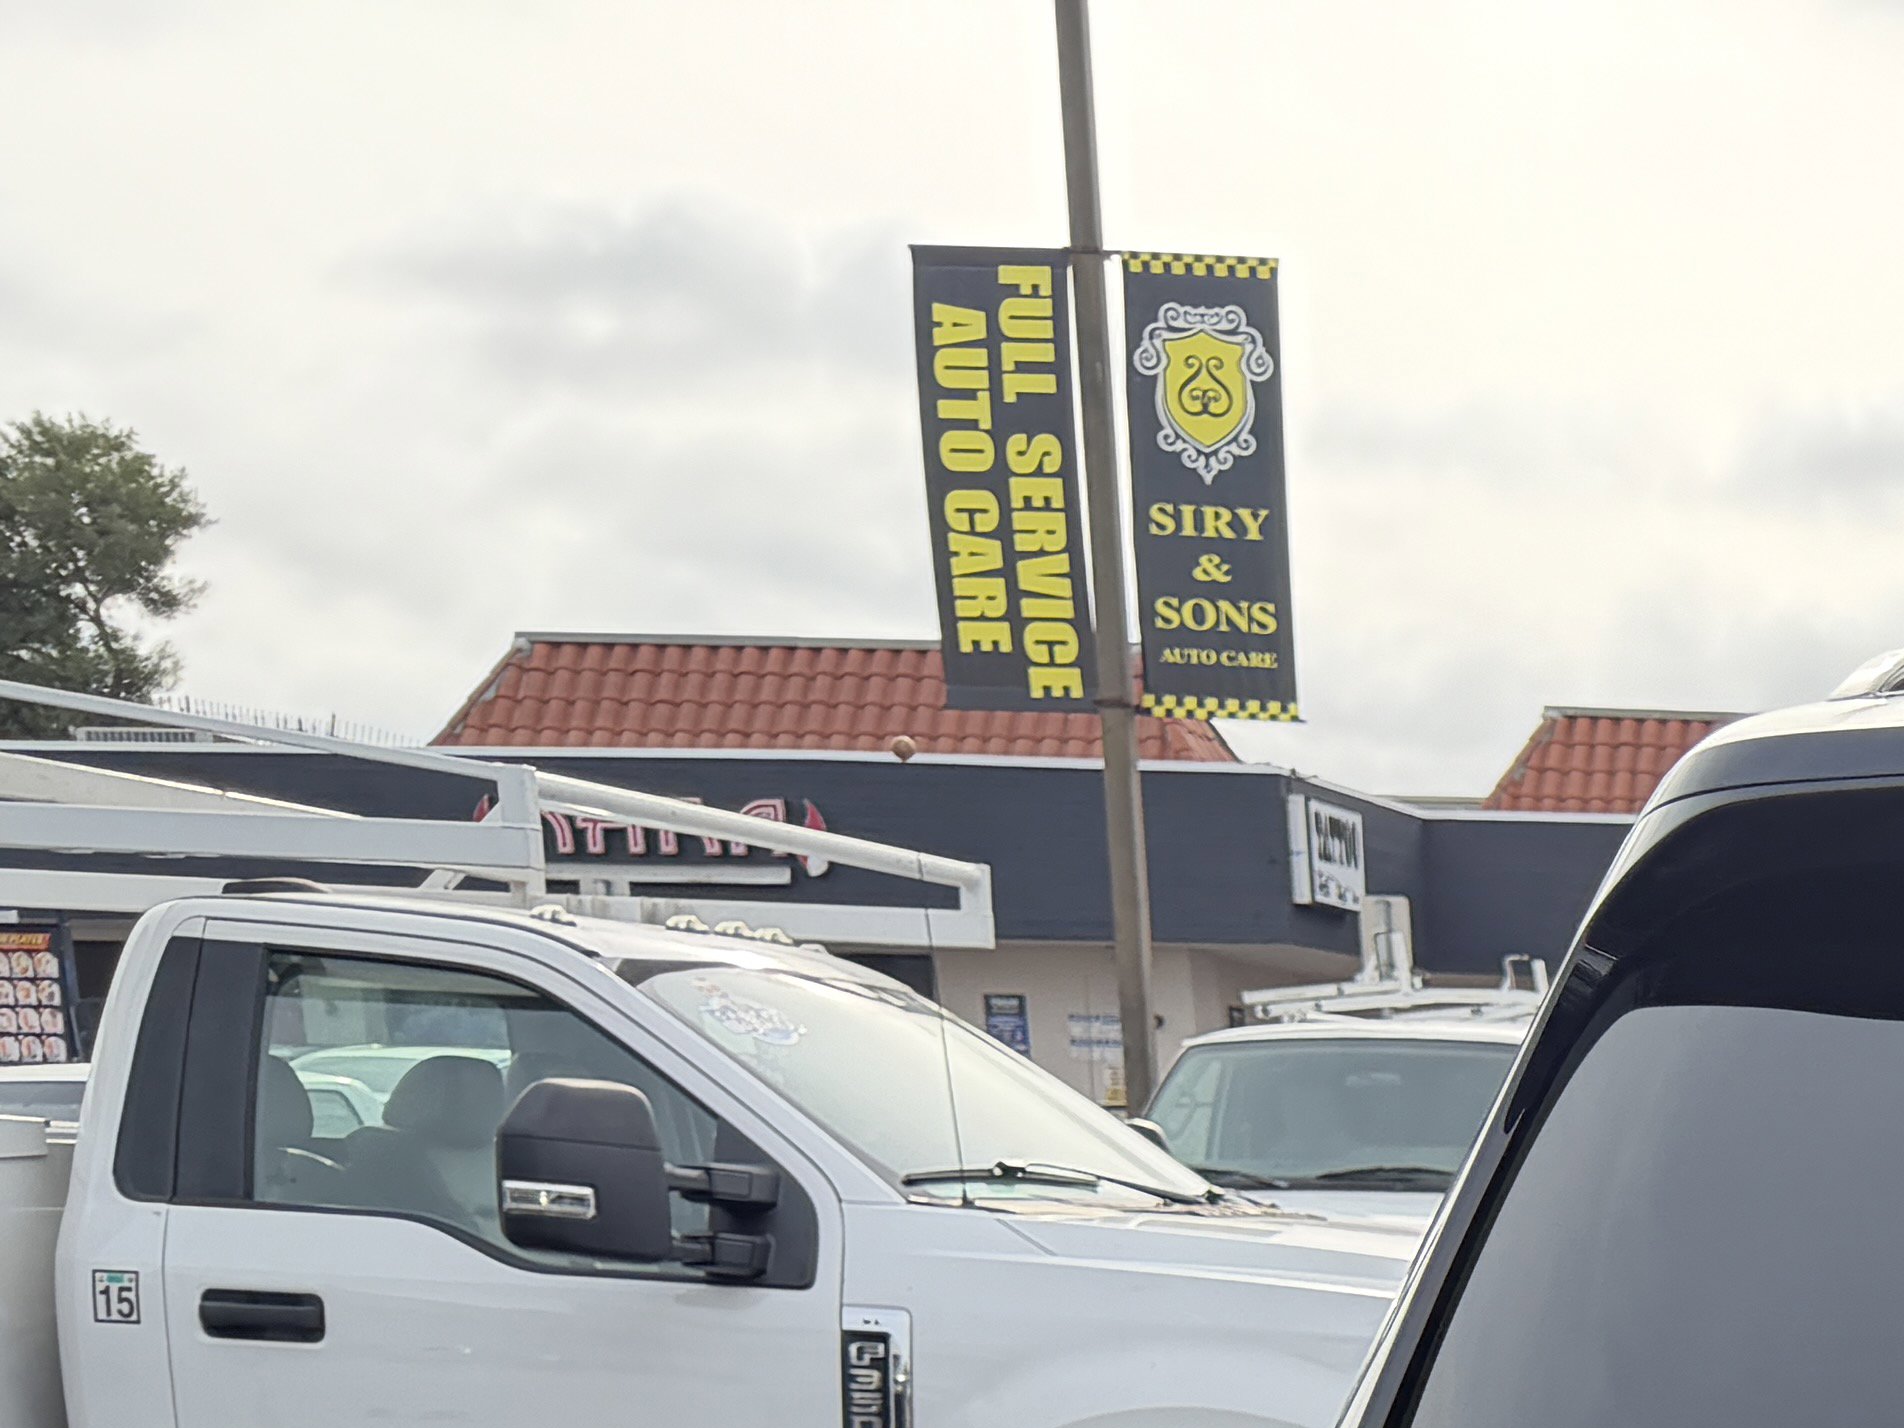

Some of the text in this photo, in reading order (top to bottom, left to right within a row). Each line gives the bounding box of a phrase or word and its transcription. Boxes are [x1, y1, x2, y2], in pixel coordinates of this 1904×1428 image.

[931, 302, 1012, 653] AUTO CARE
[998, 265, 1084, 699] FULL SERVICE
[1149, 503, 1269, 541] SIRY
[1193, 553, 1232, 583] &
[1154, 597, 1278, 635] SONS
[1160, 646, 1278, 670] AUTO CARE
[98, 1285, 135, 1319] 15
